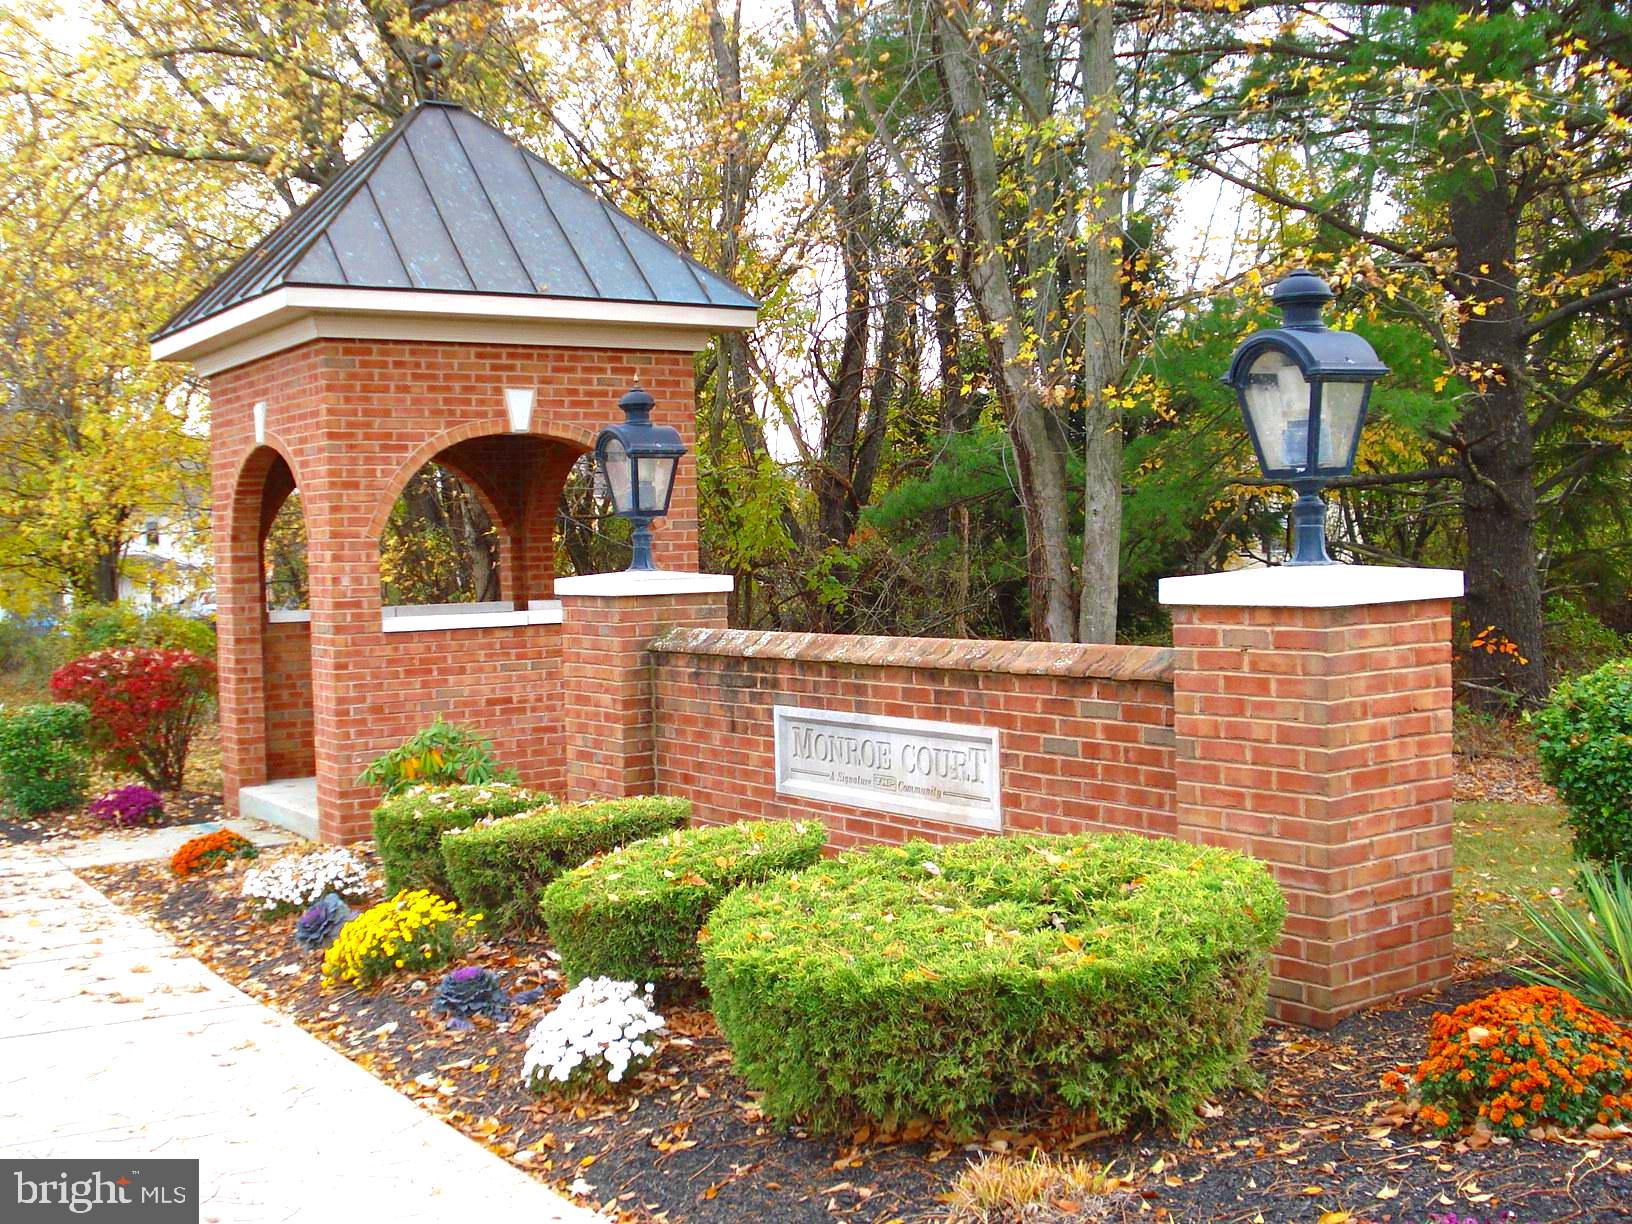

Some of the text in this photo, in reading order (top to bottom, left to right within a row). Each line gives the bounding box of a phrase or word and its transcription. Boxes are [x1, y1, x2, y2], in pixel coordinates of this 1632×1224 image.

[792, 727, 987, 784] MONROE COURT
[829, 771, 836, 782] A
[837, 772, 872, 786] Signature
[897, 781, 942, 798] Community
